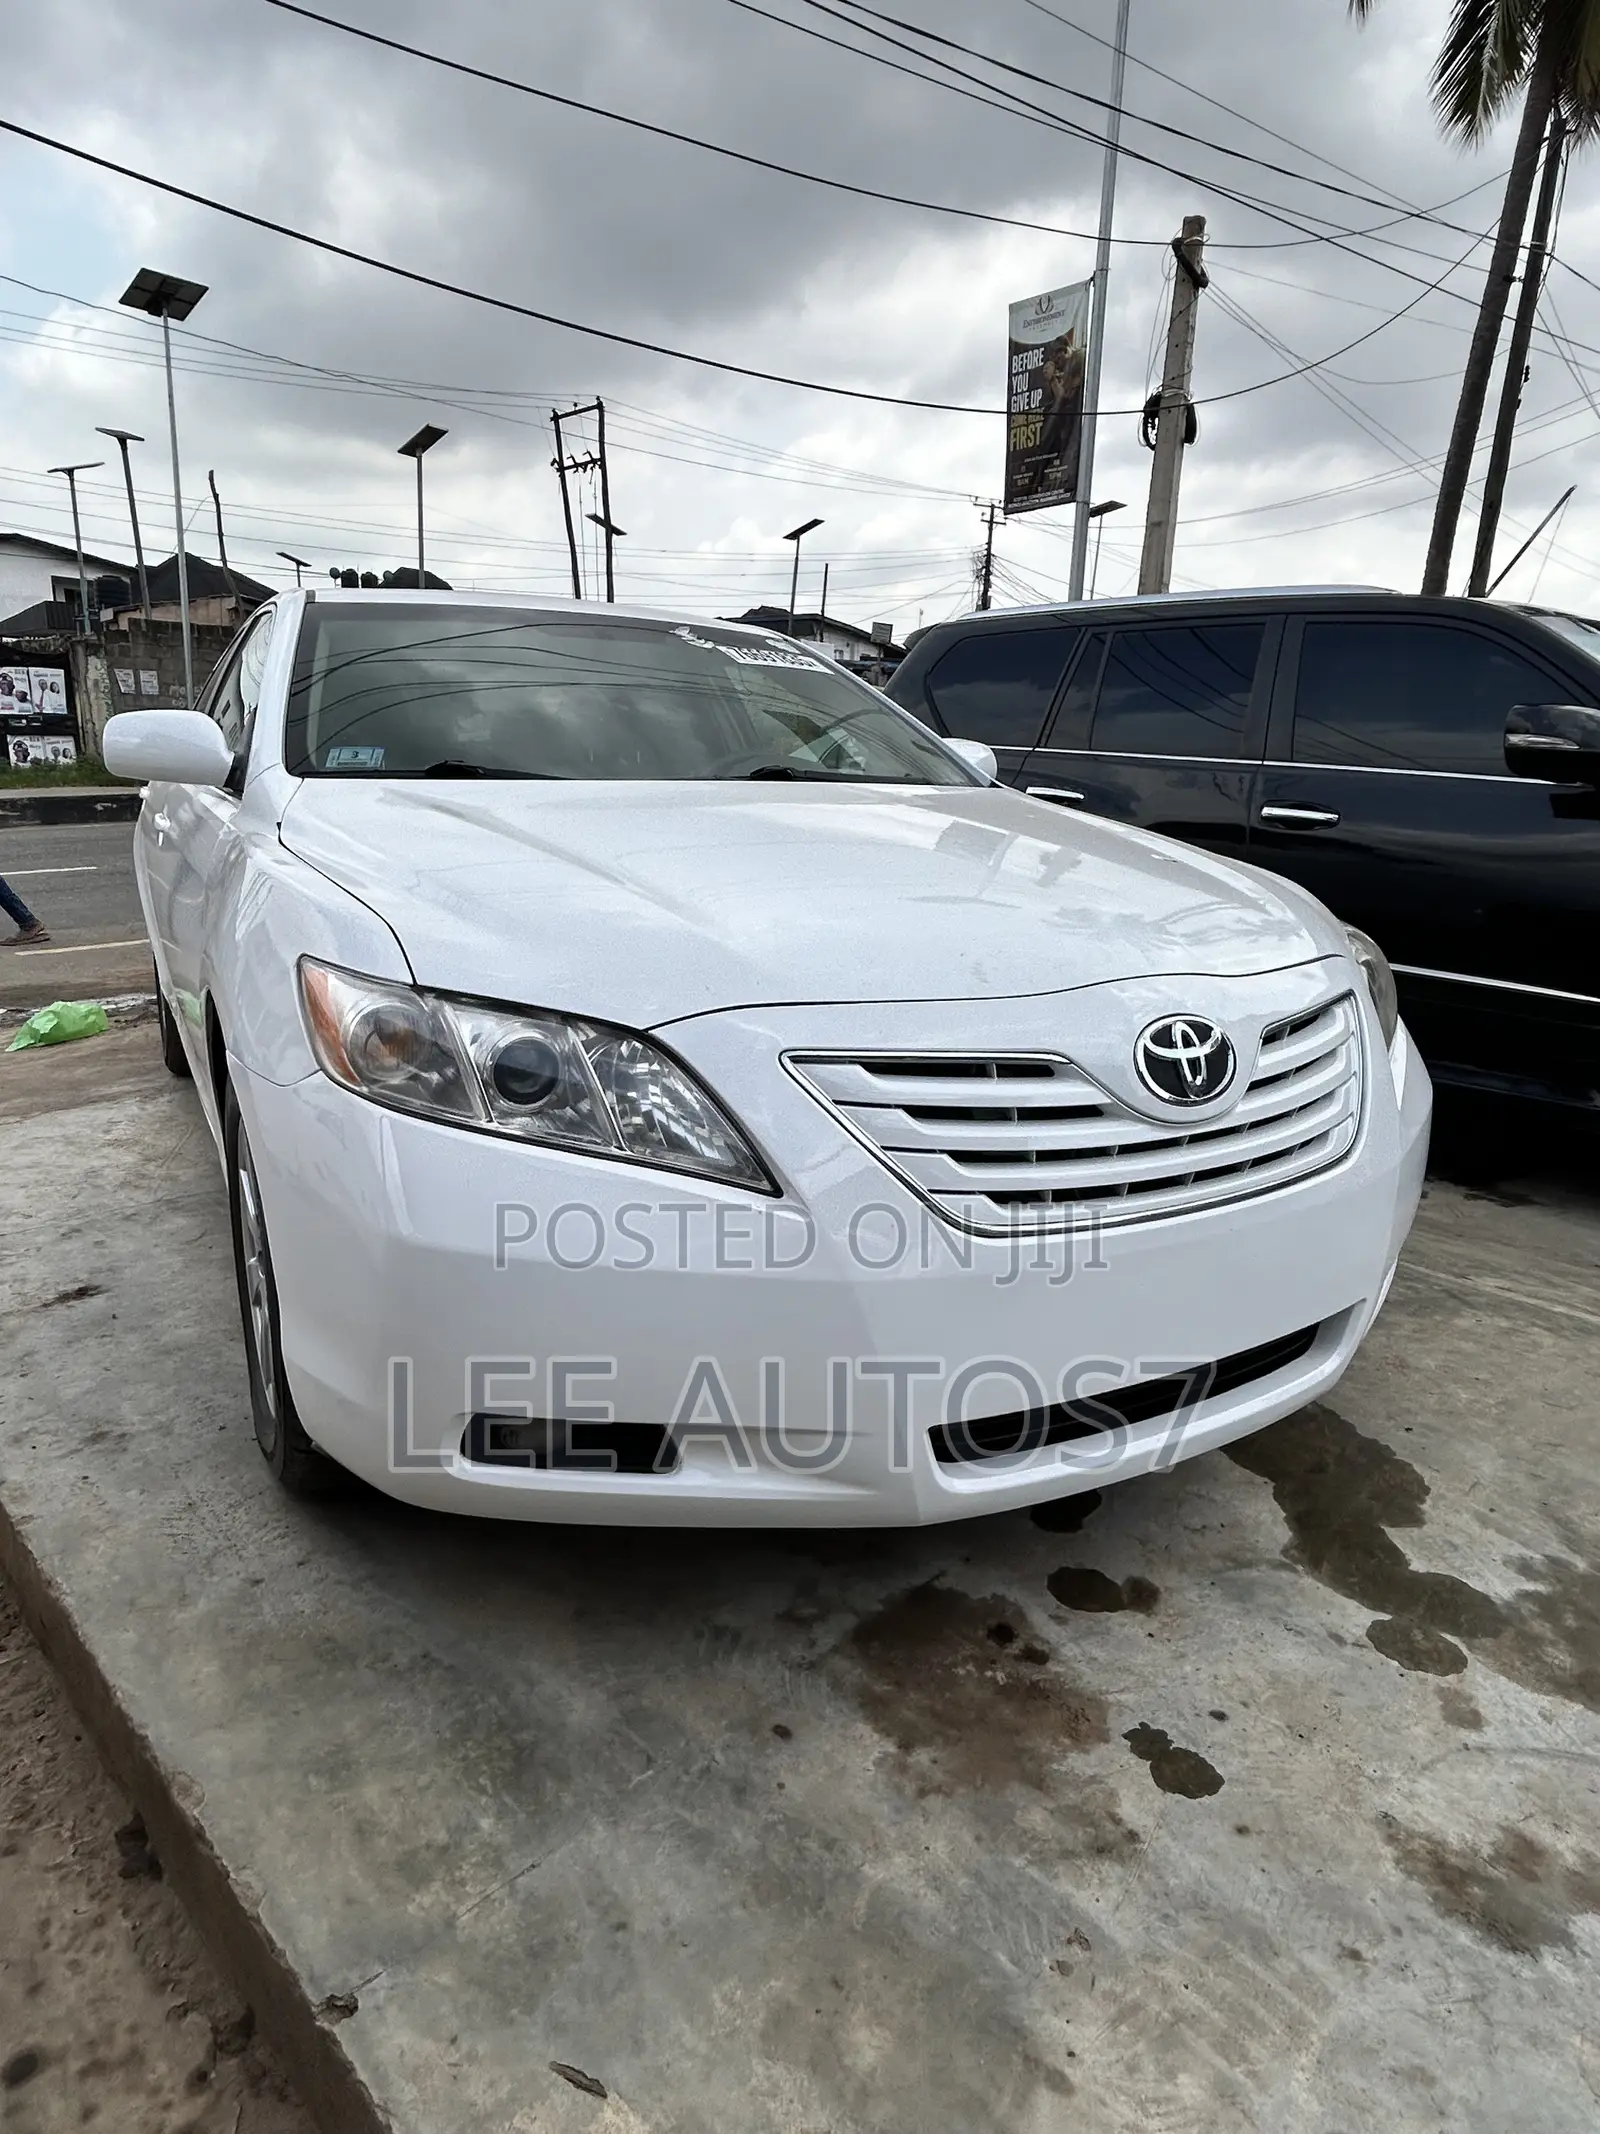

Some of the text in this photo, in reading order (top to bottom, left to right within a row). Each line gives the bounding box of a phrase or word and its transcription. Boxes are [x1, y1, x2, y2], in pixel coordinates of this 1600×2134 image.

[1012, 347, 1045, 374] BEFORE
[1012, 372, 1029, 394] YOU
[1011, 388, 1043, 413] GIVE UP
[1010, 422, 1043, 452] FIRST
